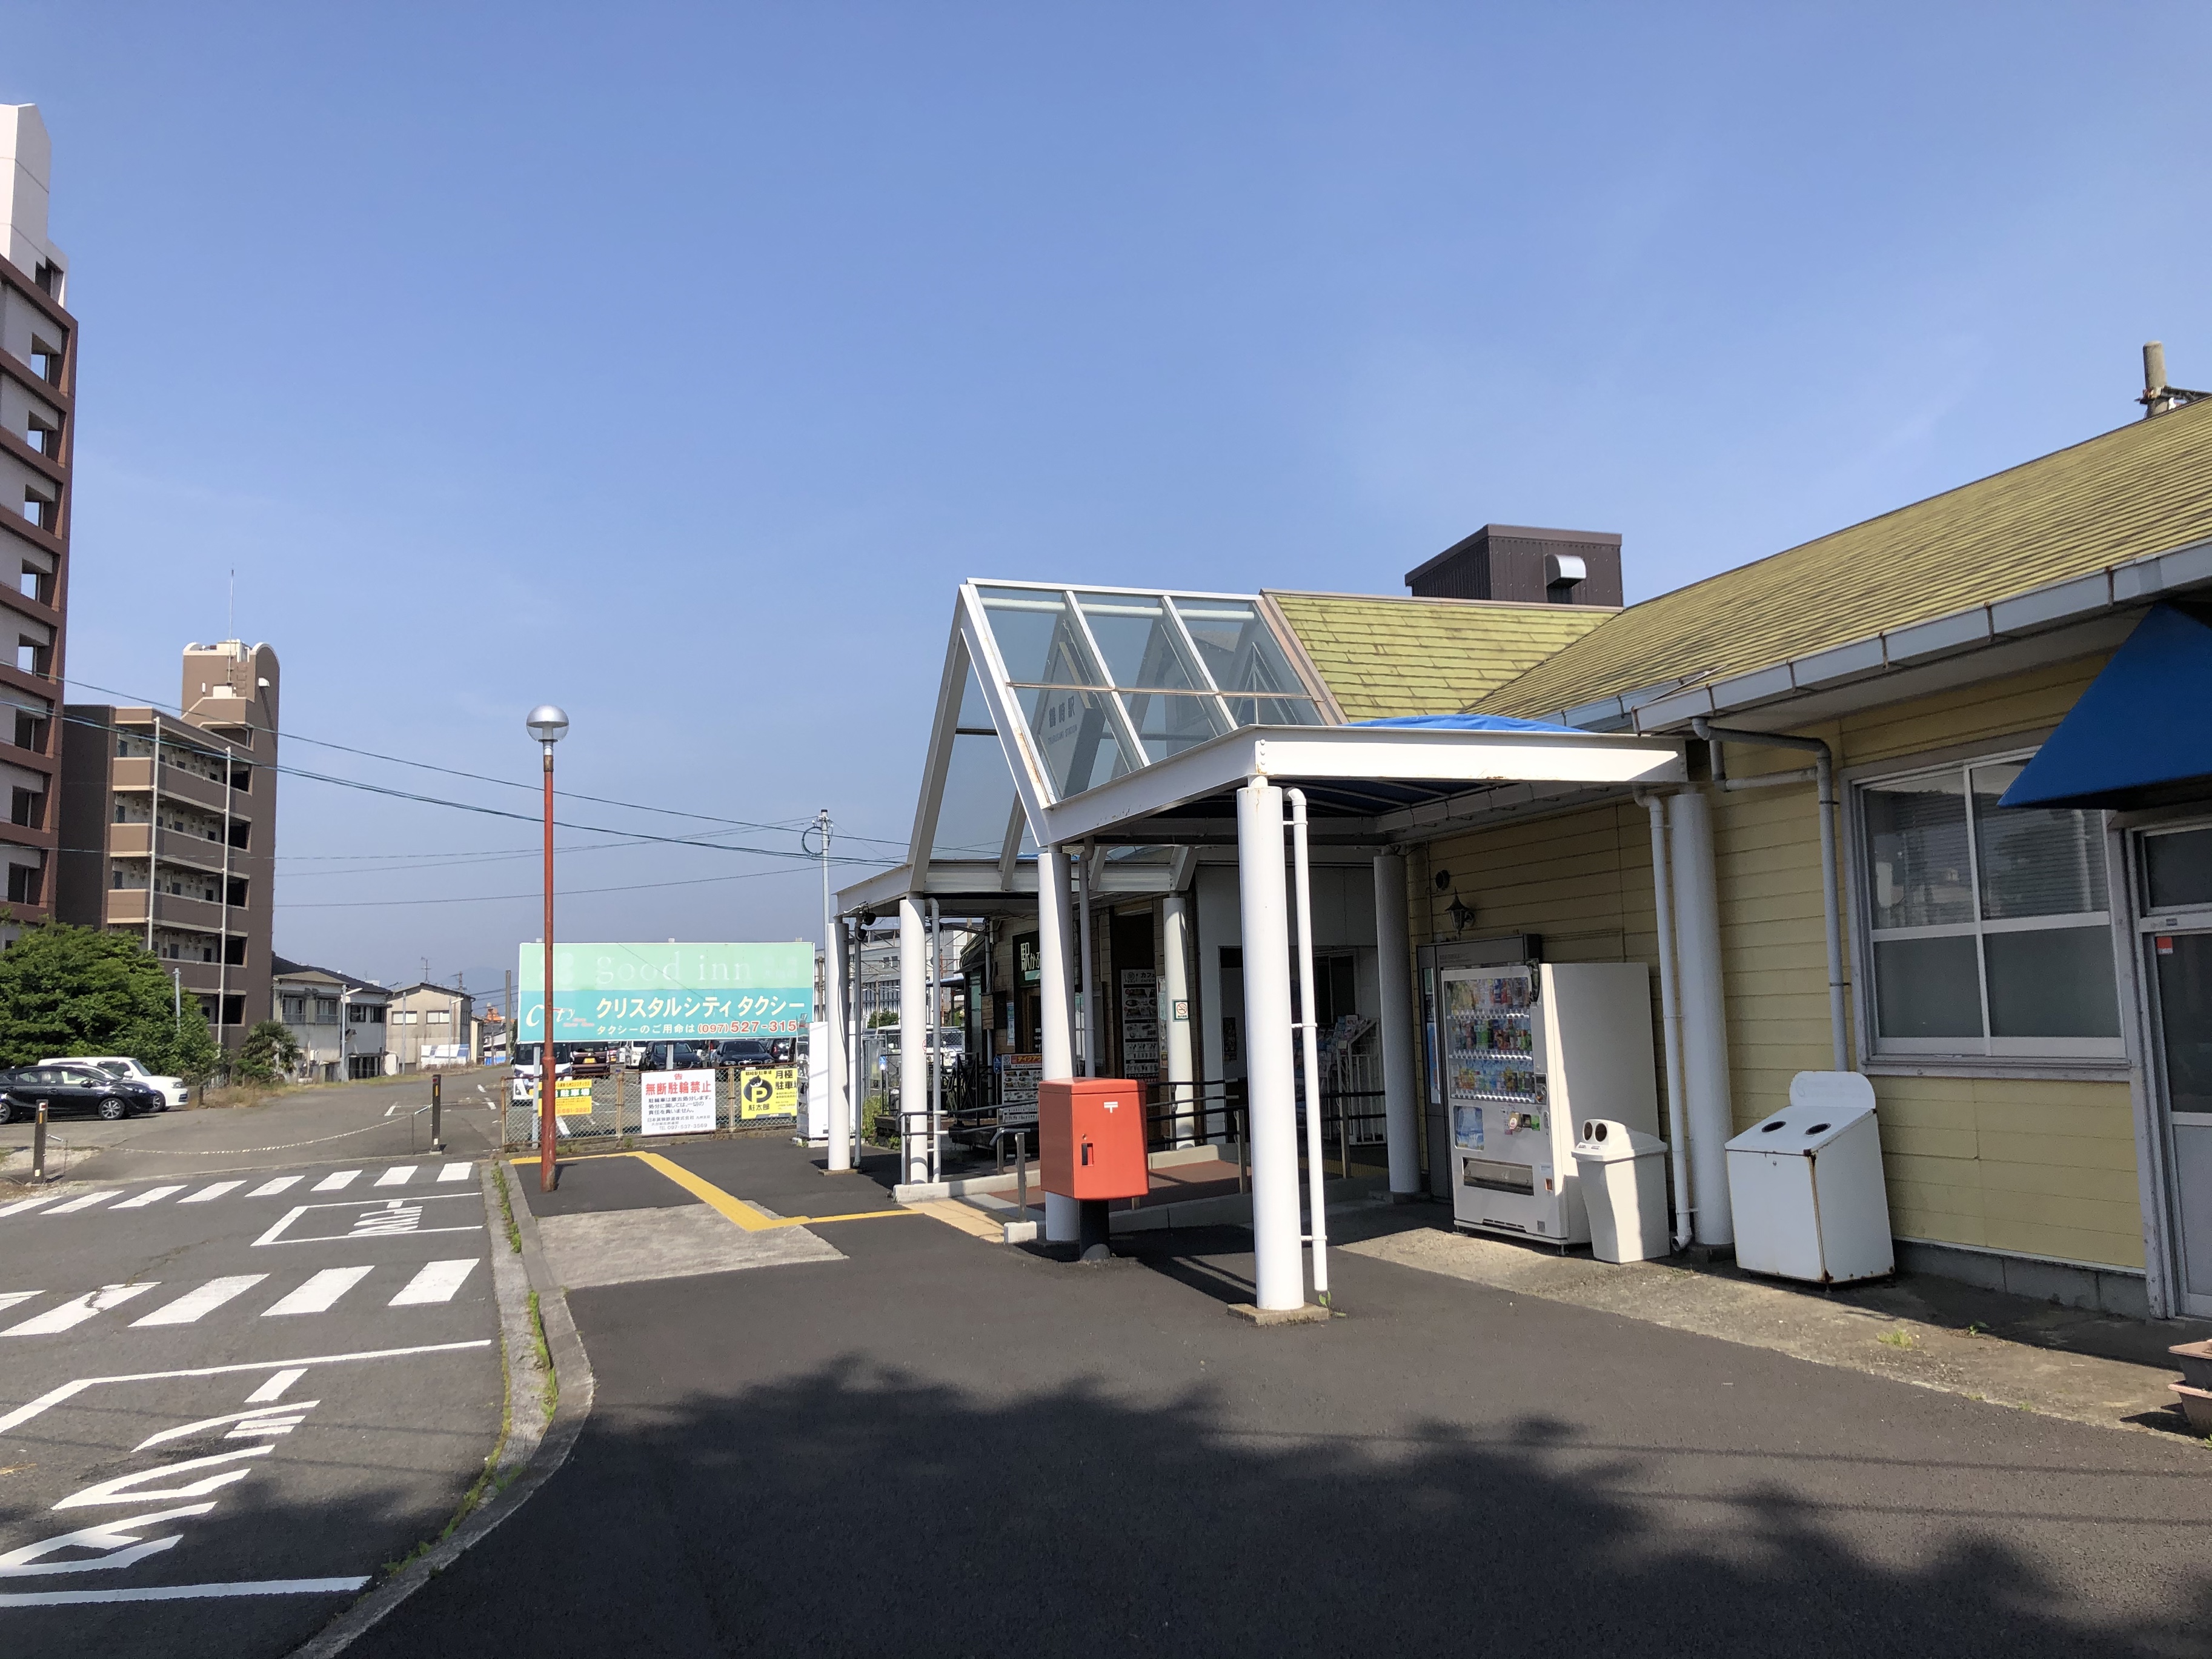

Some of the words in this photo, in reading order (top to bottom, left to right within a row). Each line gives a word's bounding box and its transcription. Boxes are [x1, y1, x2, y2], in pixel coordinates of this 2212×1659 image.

[596, 950, 680, 984] good
[699, 954, 752, 981] inn
[526, 1004, 575, 1027] Cty
[597, 1023, 695, 1035] タクシーのご用命は
[697, 1020, 798, 1034] (097)527-315
[775, 1069, 793, 1079] 月極
[555, 1088, 590, 1098] 駐車場
[645, 1080, 712, 1095] 無断駐輪禁止
